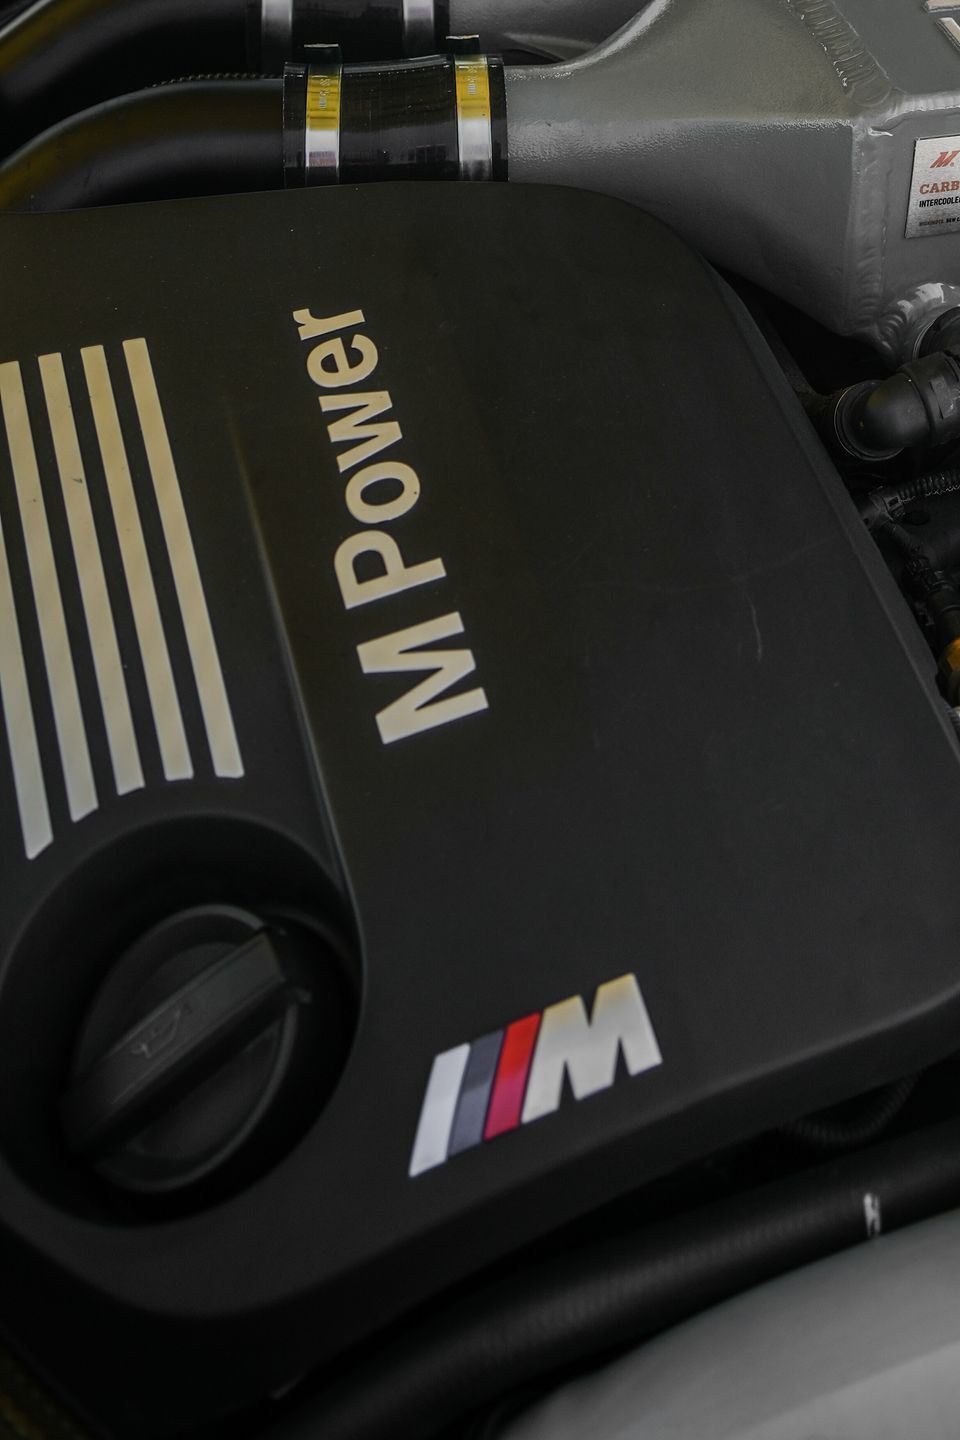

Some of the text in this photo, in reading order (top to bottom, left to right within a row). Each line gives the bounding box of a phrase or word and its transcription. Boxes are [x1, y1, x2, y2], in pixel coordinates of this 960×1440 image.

[919, 180, 960, 194] CARB
[292, 308, 489, 745] M Power
